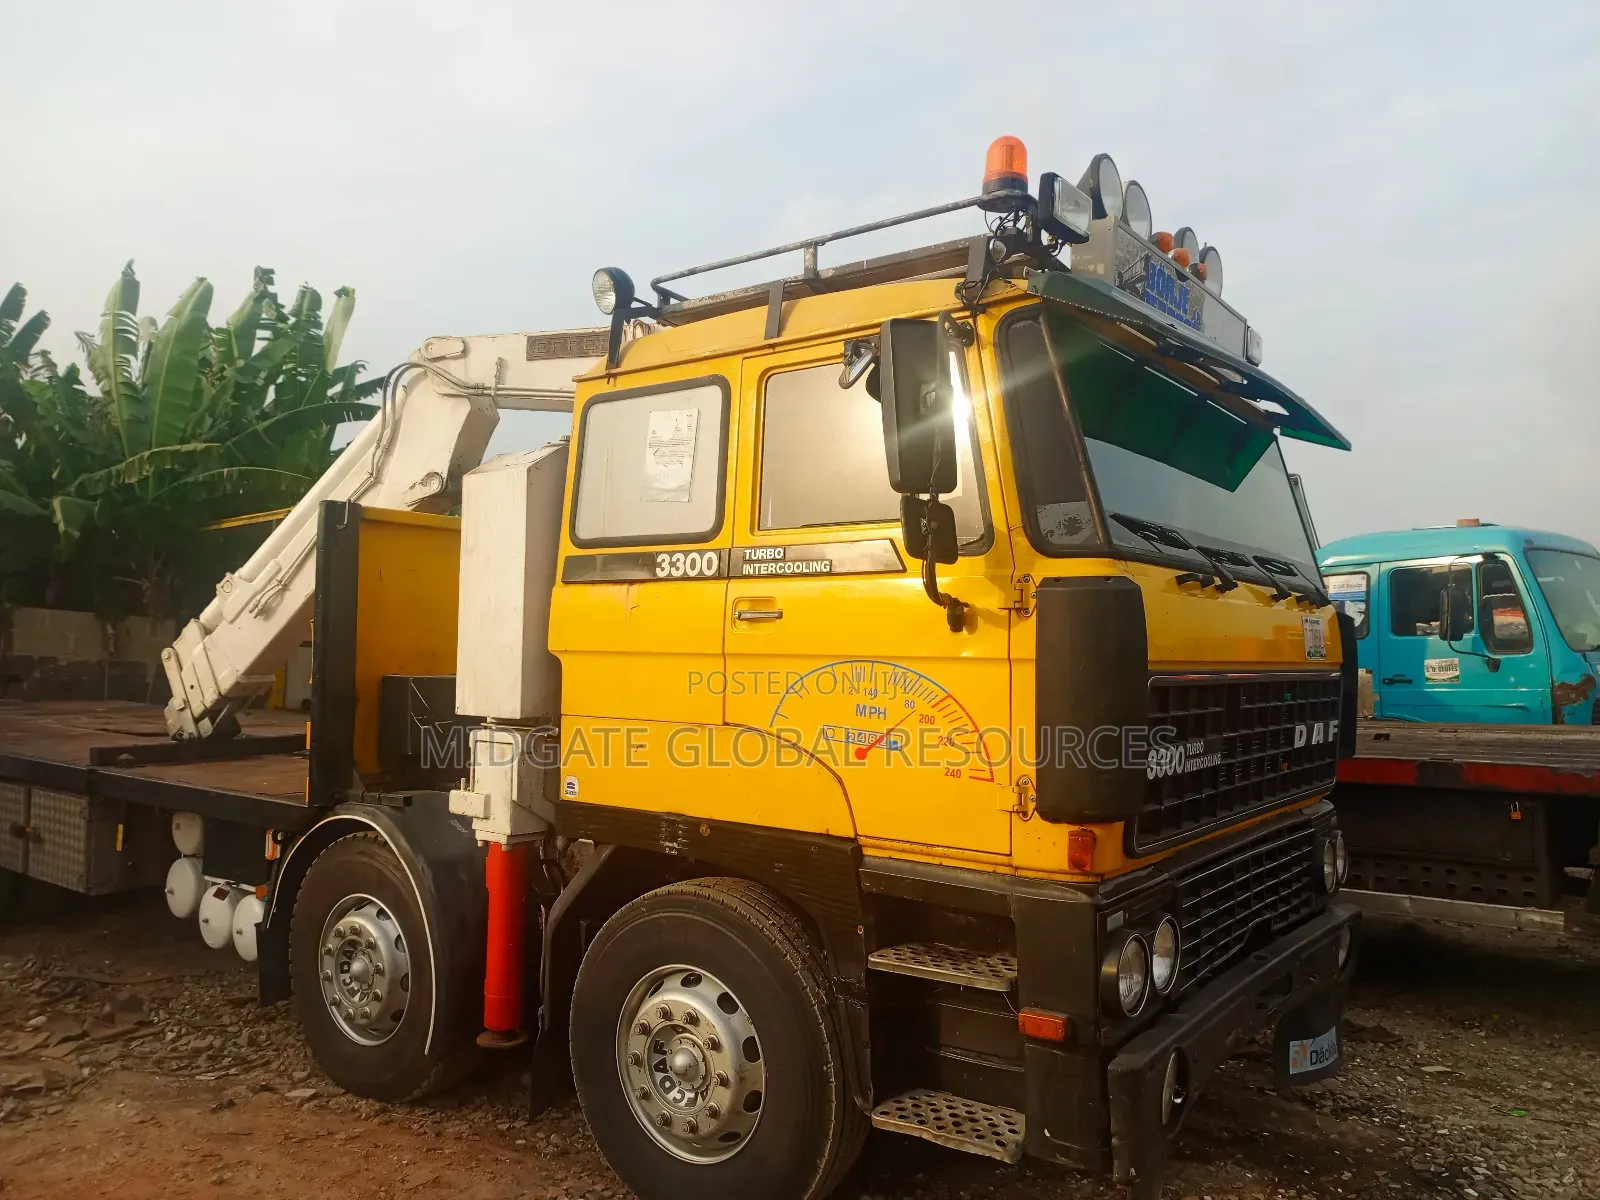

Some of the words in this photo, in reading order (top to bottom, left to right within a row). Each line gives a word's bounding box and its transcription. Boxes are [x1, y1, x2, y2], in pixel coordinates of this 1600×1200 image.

[744, 547, 784, 560] TURBO
[655, 551, 718, 578] 3300
[743, 560, 830, 575] INTERCOOLING
[904, 699, 916, 710] 80
[855, 703, 887, 721] MPH
[918, 713, 935, 726] 200
[1294, 719, 1339, 748] DAF
[938, 735, 954, 748] 220
[1146, 744, 1186, 780] 3300
[944, 766, 962, 780] 240
